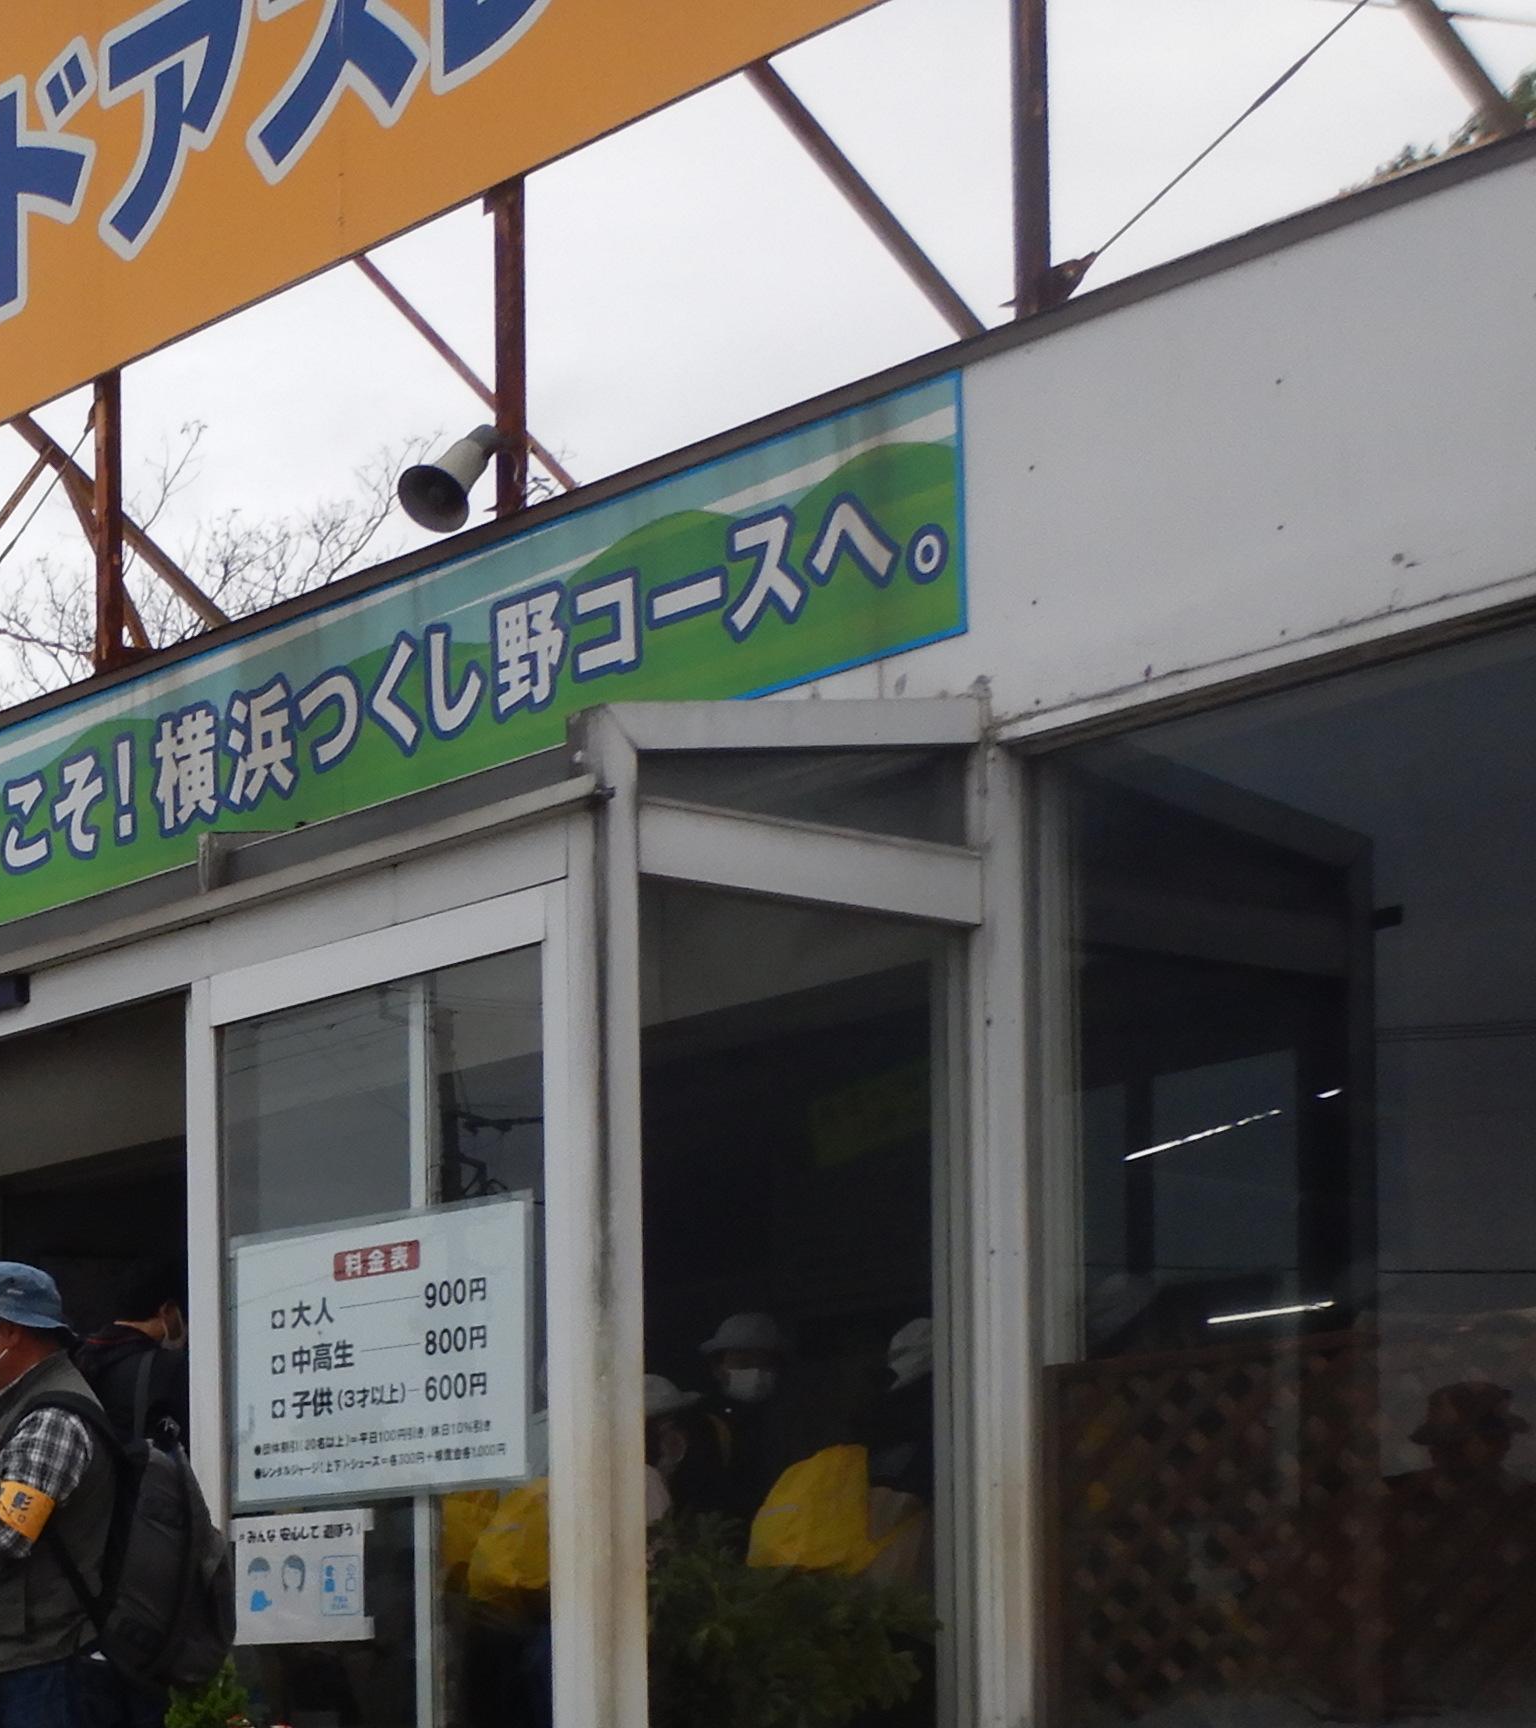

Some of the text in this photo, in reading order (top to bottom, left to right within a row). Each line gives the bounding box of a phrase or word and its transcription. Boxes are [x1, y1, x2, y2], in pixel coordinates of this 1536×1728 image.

[344, 1245, 409, 1277] 料金表
[291, 1277, 487, 1328] 大人 900円
[291, 1325, 487, 1374] 中高生 800円
[425, 1372, 487, 1401] 600円
